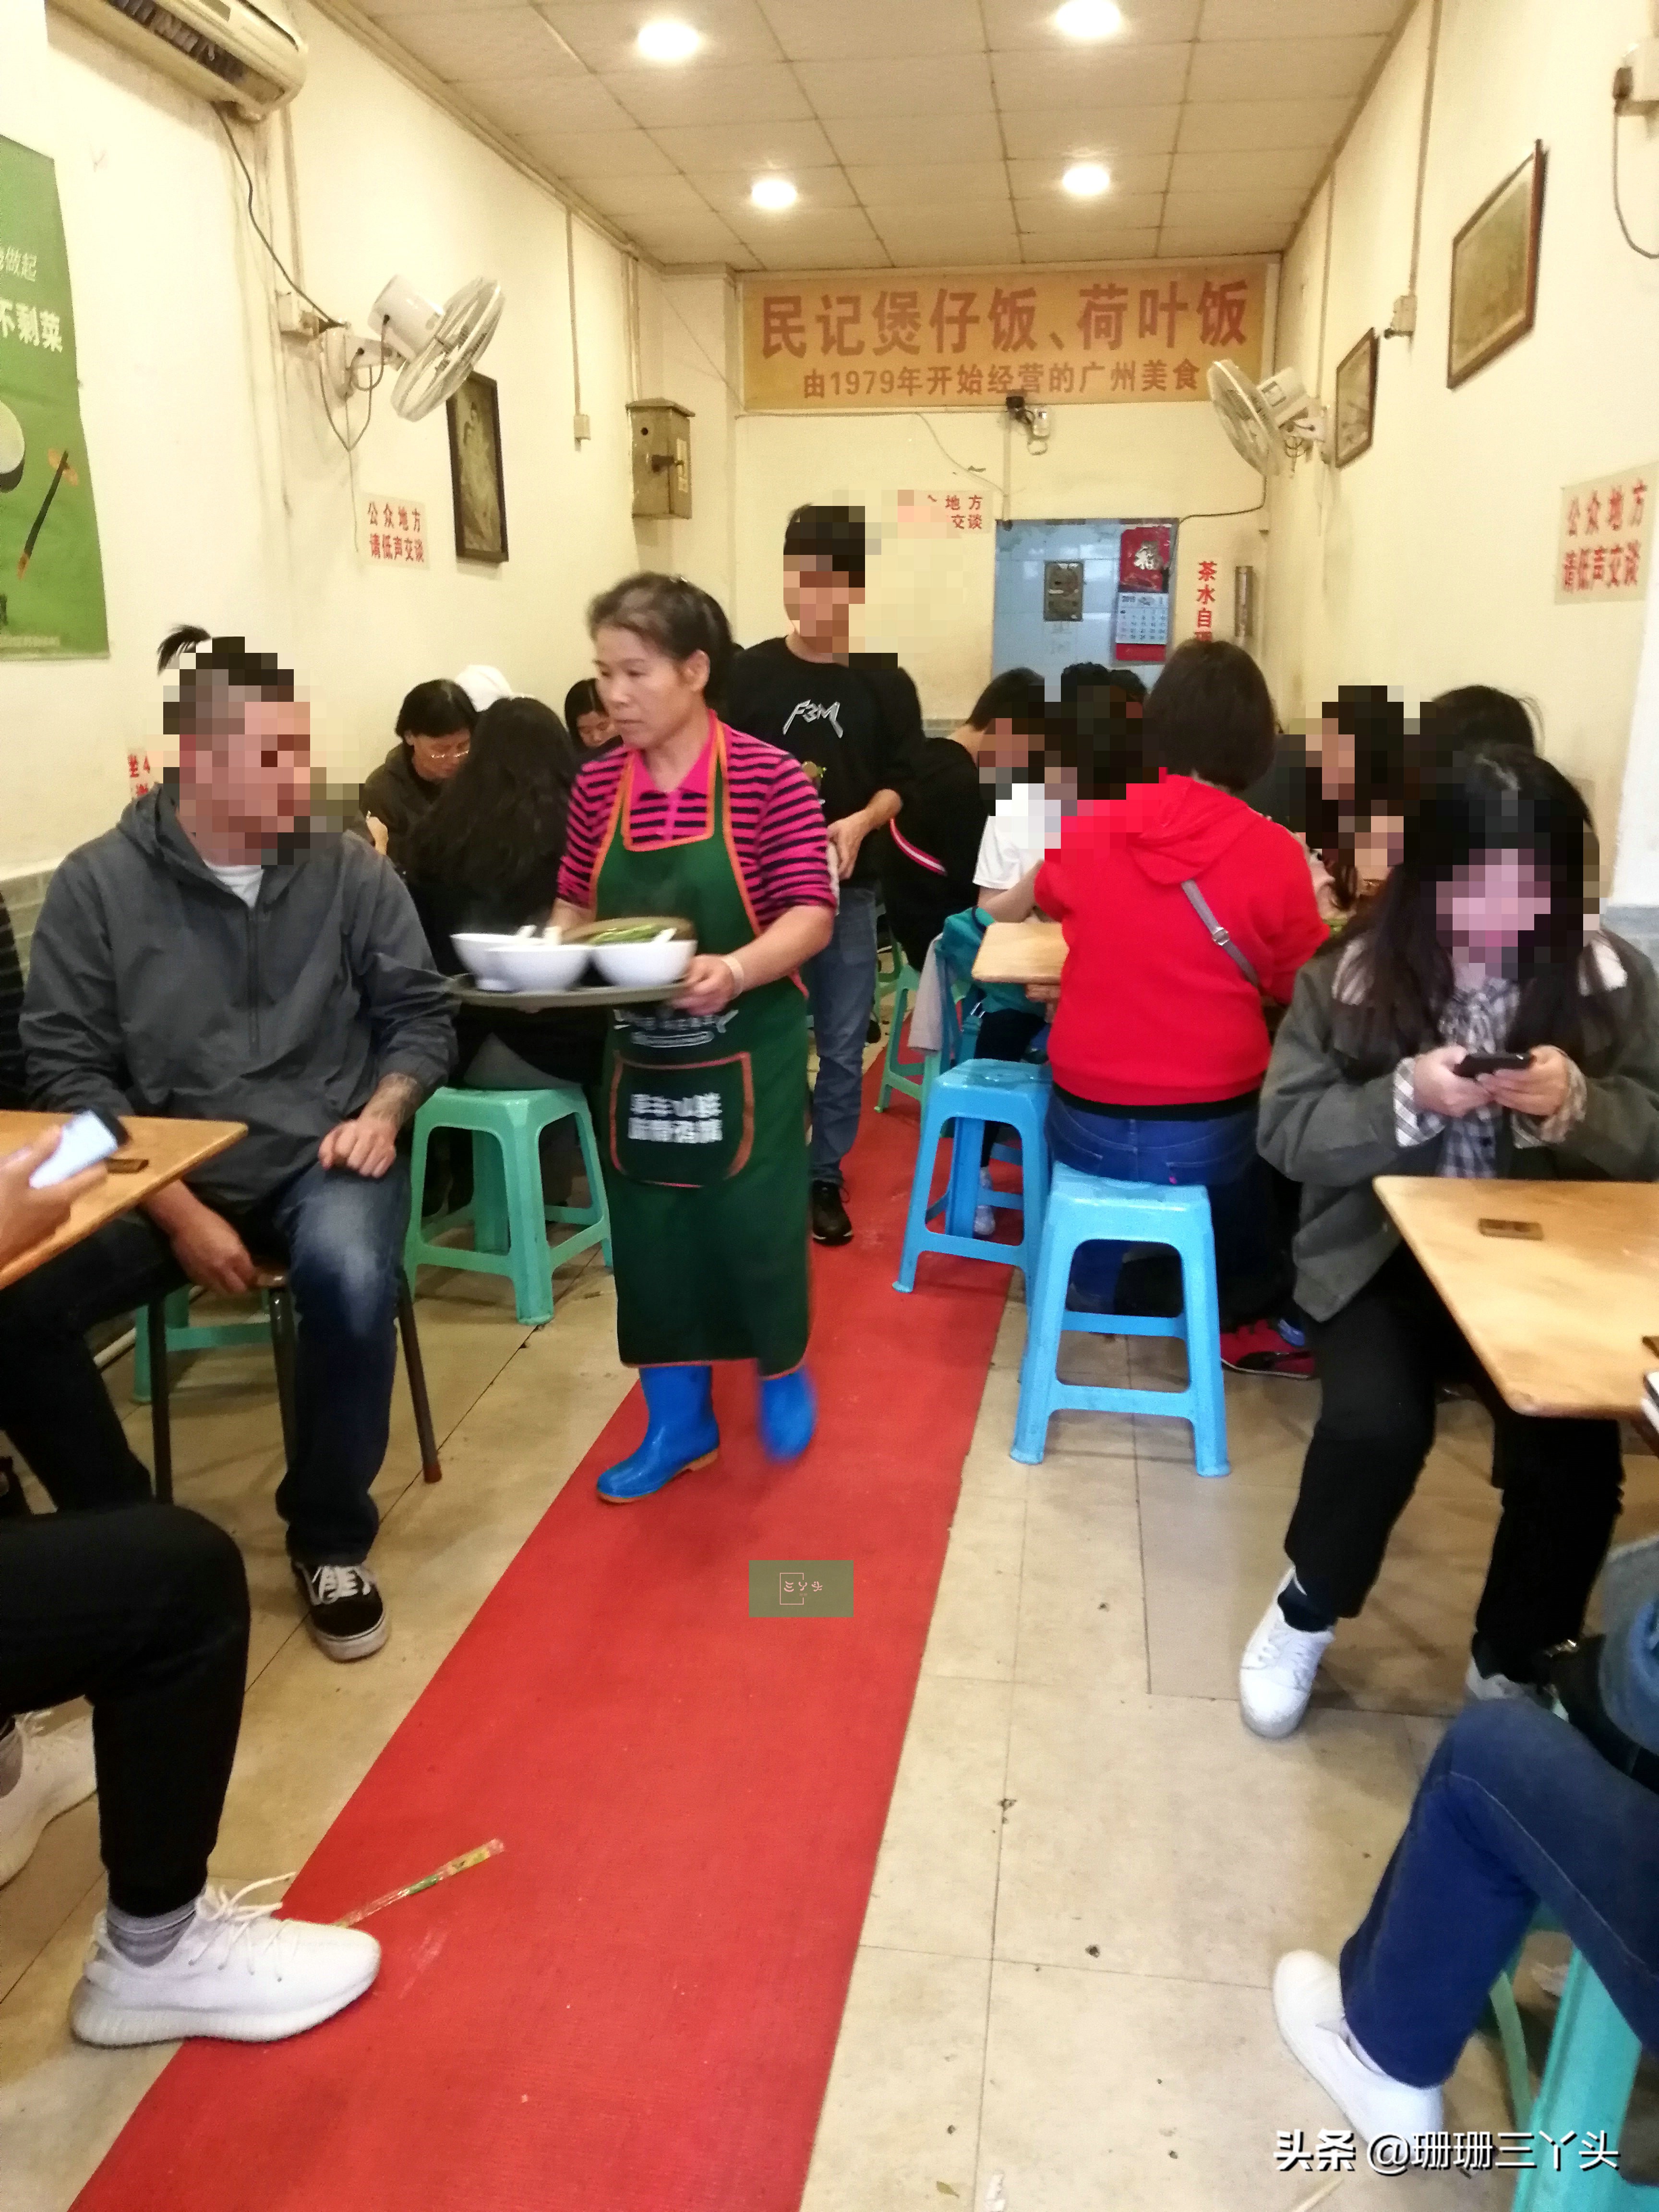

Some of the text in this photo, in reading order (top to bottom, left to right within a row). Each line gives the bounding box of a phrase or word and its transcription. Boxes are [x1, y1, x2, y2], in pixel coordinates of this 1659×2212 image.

[761, 280, 1248, 359] 民记煲仔饭、荷叶饭
[803, 358, 1200, 400] 由1979年开始经营的广州美食
[368, 501, 421, 532] 公众地方
